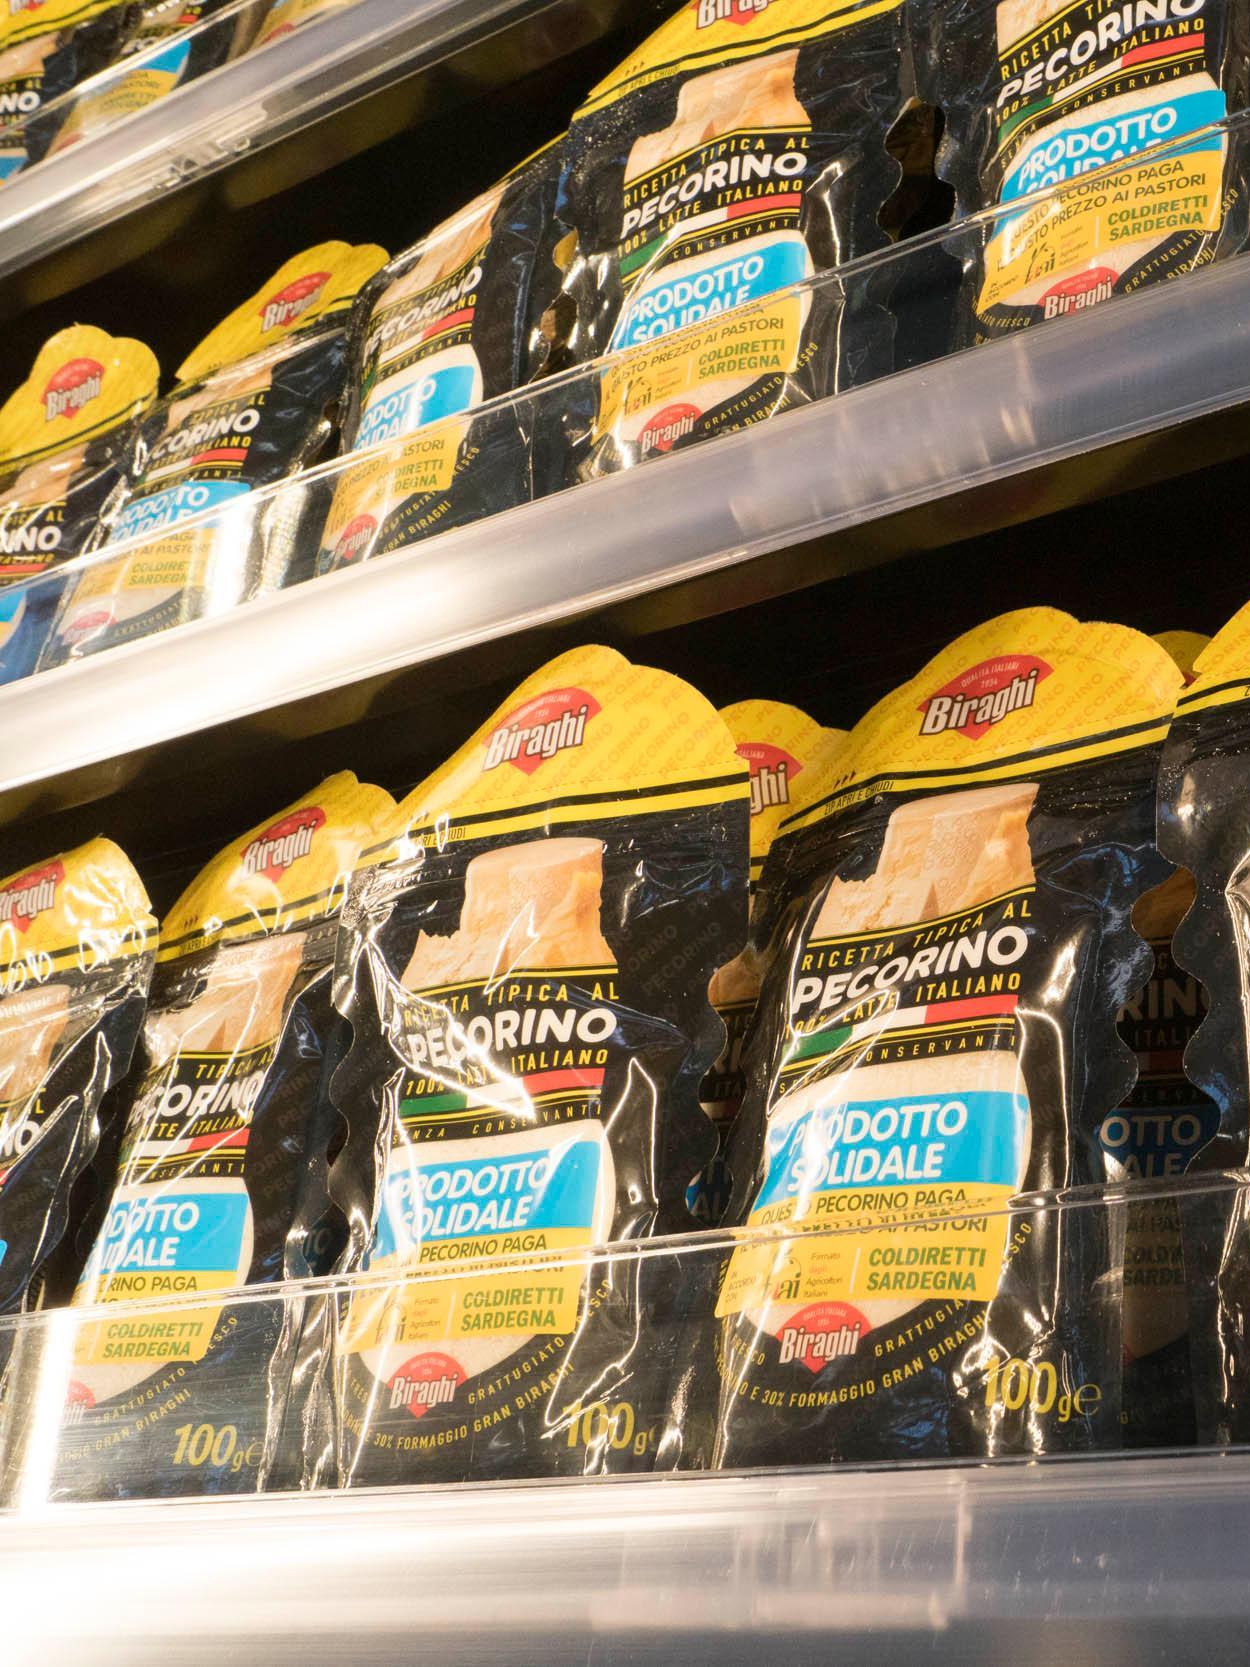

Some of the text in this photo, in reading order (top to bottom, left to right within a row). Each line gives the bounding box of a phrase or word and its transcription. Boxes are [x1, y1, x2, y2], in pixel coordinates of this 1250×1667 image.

[996, 0, 1203, 108] PECORINO
[1000, 24, 1072, 81] RICETTA
[1046, 60, 1097, 97] LATTE
[1113, 18, 1205, 60] ITALIANO
[1061, 60, 1207, 115] CONSERVANTI
[1018, 106, 1177, 191] PRODOTTO
[1137, 160, 1185, 183] PAGA
[620, 152, 808, 239] PECORINO
[624, 137, 811, 209] RICETTA TIPICA AL
[617, 180, 803, 256] 100% LATTE ITALIANO
[1052, 195, 1107, 230] PREZZO
[1112, 191, 1129, 204] AI
[1135, 174, 1206, 199] PASTORI
[1107, 195, 1209, 226] COLDIRETTI
[1109, 212, 1204, 241] SARDEGNA
[630, 255, 764, 323] PRODOTTO
[1044, 276, 1112, 321] Biraghi
[650, 318, 785, 368] PREZZO AI PASTORI
[698, 339, 786, 366] COLDIRETTI
[698, 355, 781, 380] SARDEGNA
[704, 376, 782, 430] GRATTUGIATO
[641, 413, 696, 455] Biraghi
[919, 668, 1040, 737] Biraghi
[481, 705, 589, 772] Biraghi
[243, 819, 319, 875] Biraghi
[801, 900, 1032, 972] RICETTA TIPICA AL
[791, 925, 1028, 1014] PECORINO
[487, 982, 568, 1006] TIPICA
[592, 982, 619, 1000] AL
[843, 992, 897, 1023] LATTE
[916, 973, 1021, 1003] ITALIANO
[407, 1008, 618, 1067] PECORINO
[511, 1049, 608, 1073] ITALIANO
[816, 1189, 966, 1215] PECORINO PAGA
[419, 1234, 547, 1263] PECORINO PAGA
[869, 1247, 986, 1268] COLDIRETTI
[152, 1276, 197, 1292] PAGA
[464, 1287, 564, 1310] COLDIRETTI
[867, 1271, 977, 1292] SARDEGNA
[107, 1323, 203, 1339] COLDIRETTI
[461, 1310, 556, 1331] SARDEGNA
[779, 1321, 861, 1364] Biraghi
[103, 1342, 191, 1358] SARDEGNA
[468, 1337, 566, 1405] GRATTUGIATO
[390, 1373, 458, 1409] Biraghi
[751, 1386, 760, 1400] E
[762, 1390, 786, 1407] 30%
[789, 1380, 875, 1408] FORMAGGIO
[883, 1357, 924, 1388] GRAN
[374, 1432, 393, 1448] 30%
[397, 1425, 467, 1449] FORMAGGIO
[473, 1407, 511, 1433] GRAN
